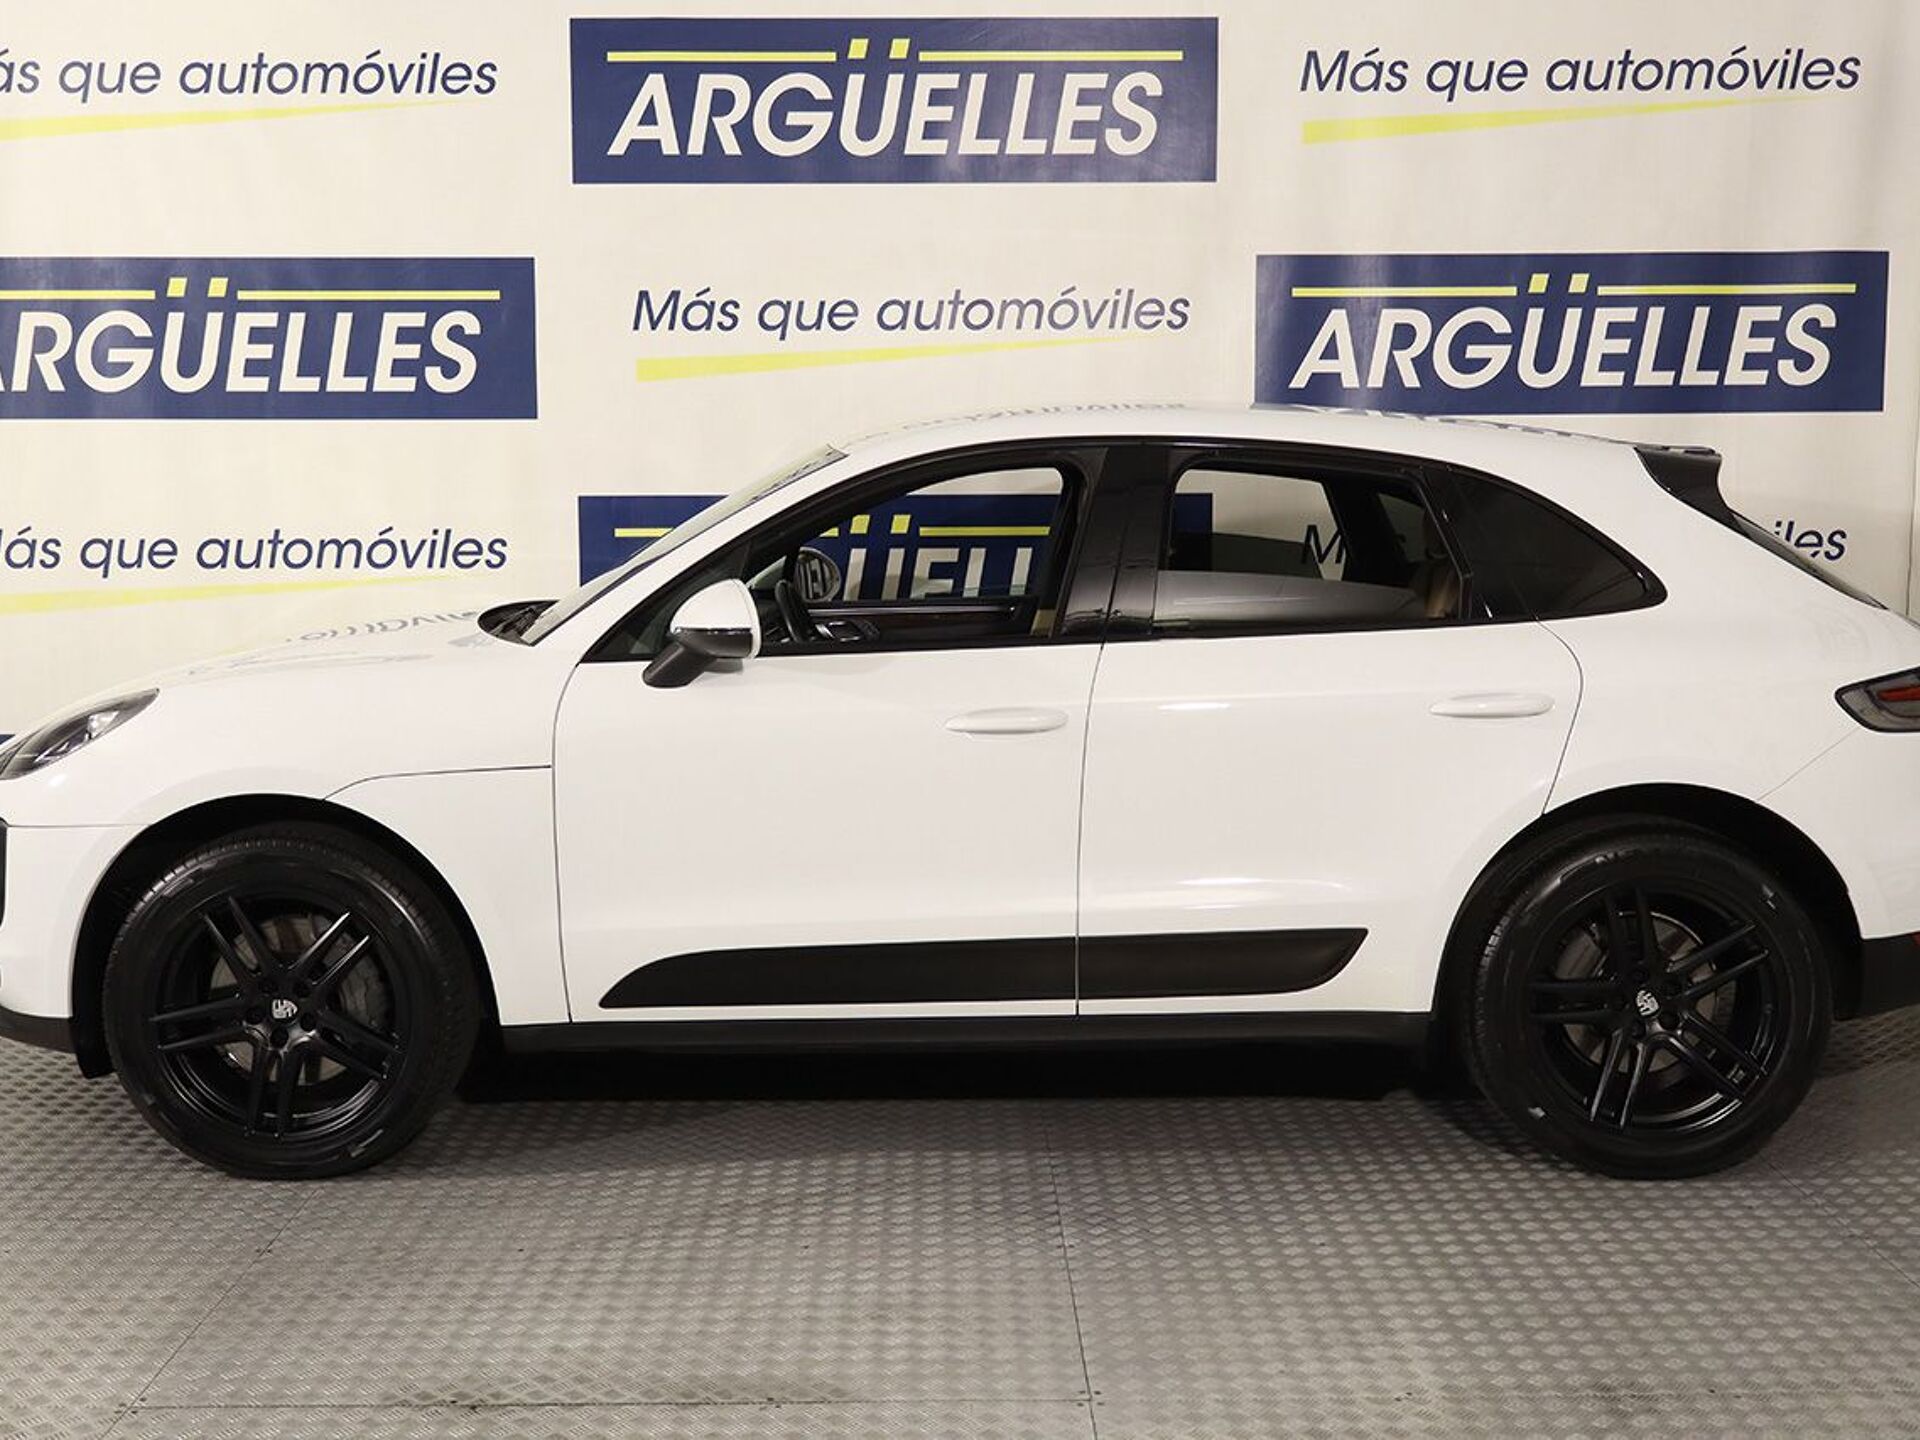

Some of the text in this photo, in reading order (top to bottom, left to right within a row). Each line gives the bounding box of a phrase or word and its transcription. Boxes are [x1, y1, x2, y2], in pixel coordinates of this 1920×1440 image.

[59, 61, 161, 104] que
[179, 49, 498, 95] automóviles
[607, 38, 1163, 157] ARGÜELLES
[1300, 45, 1861, 103] Más que automóviles
[0, 277, 481, 393] RGÜELLES
[632, 285, 1190, 341] Más que automóviles
[1288, 273, 1836, 389] ARGÜELLES
[0, 526, 508, 579] ás que automóviles
